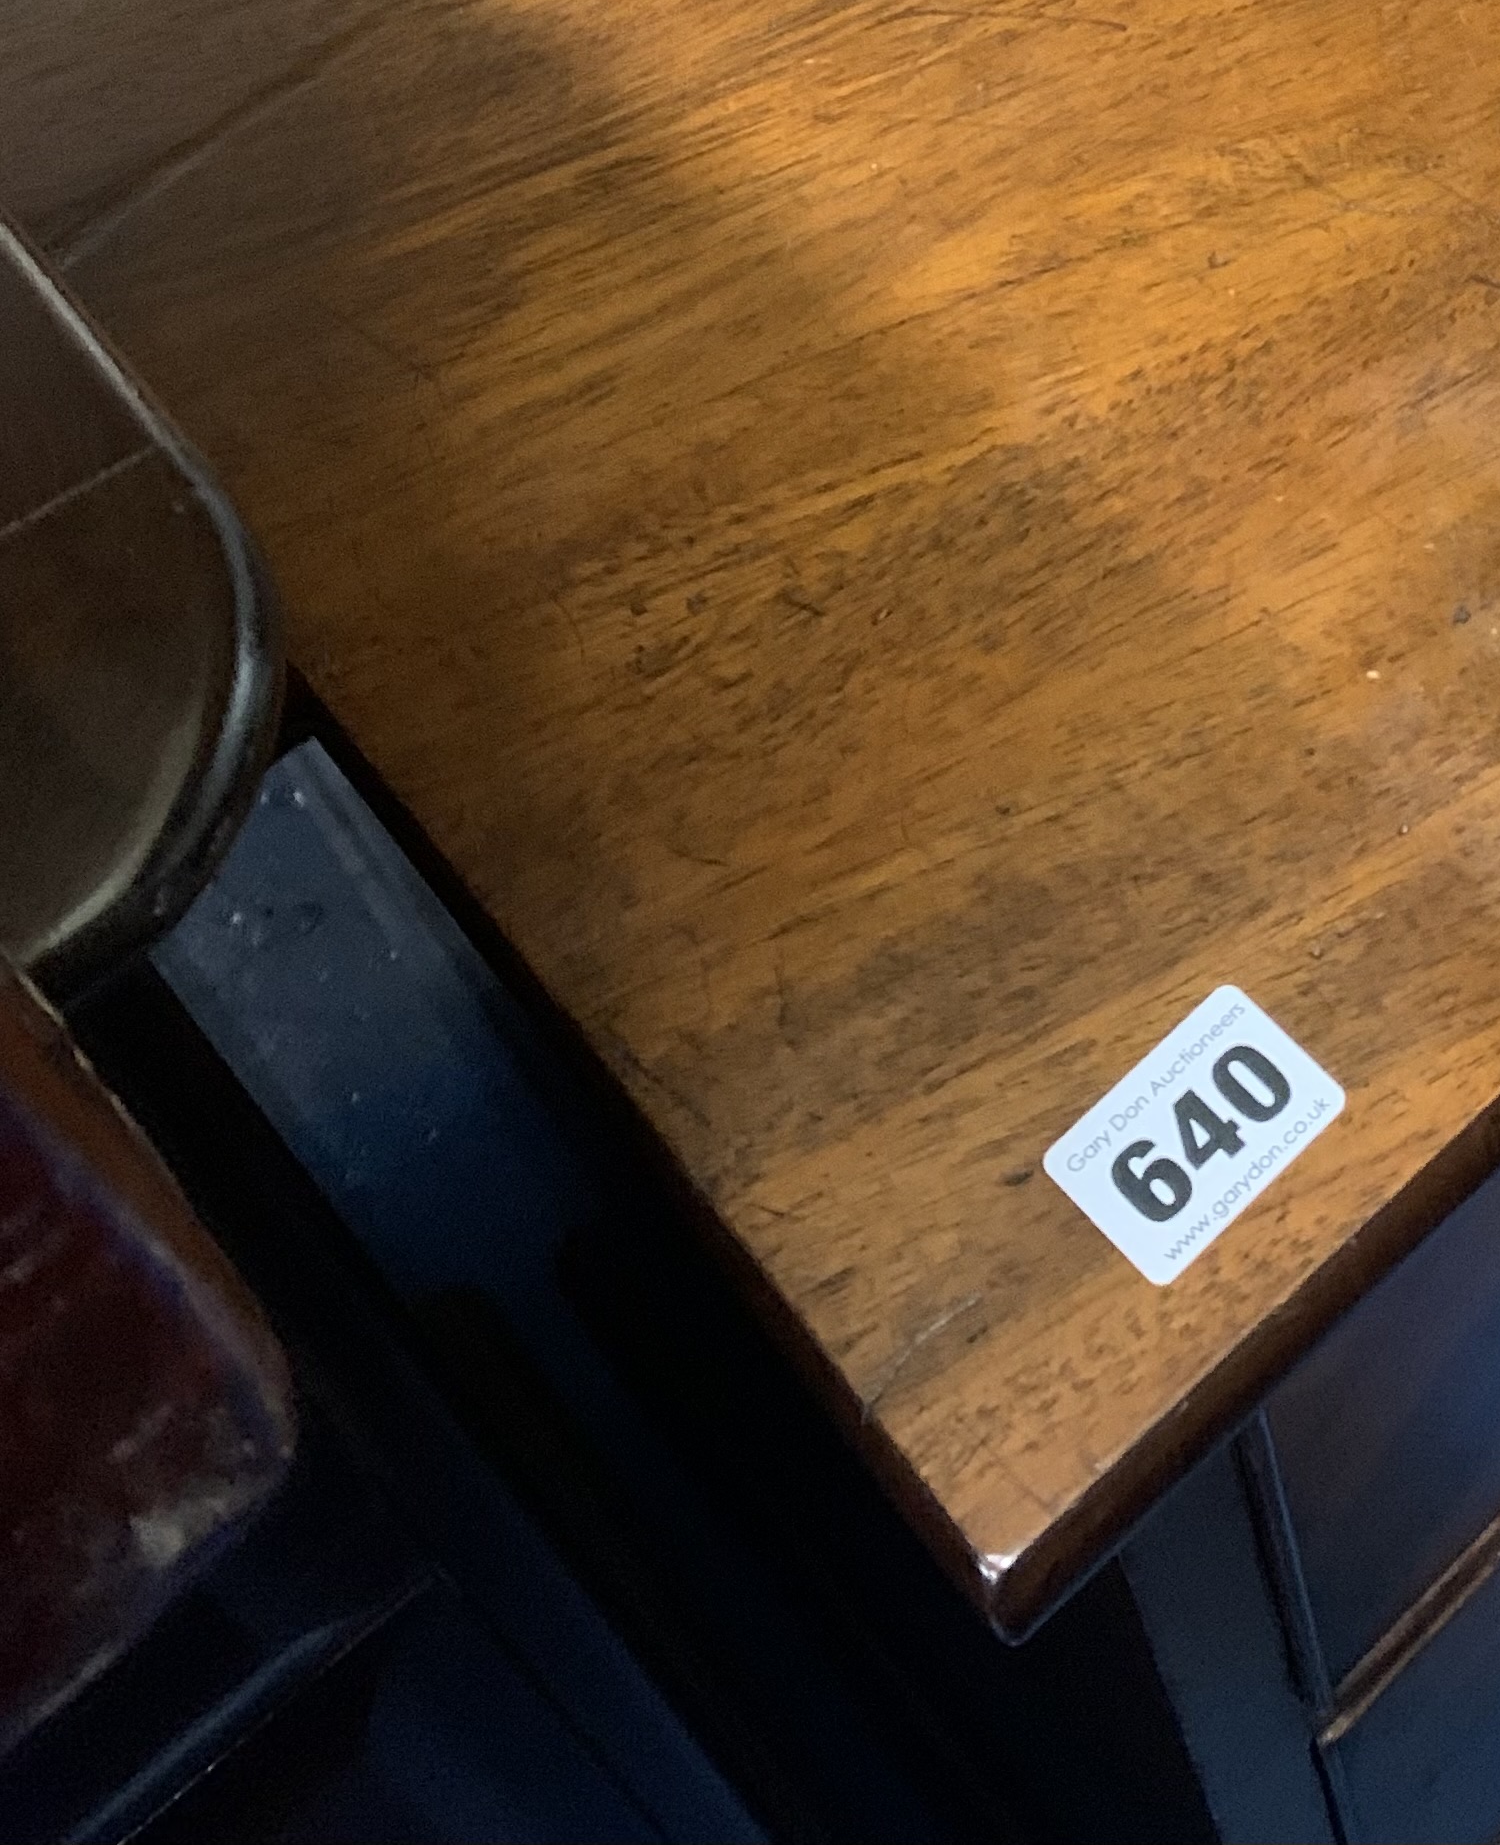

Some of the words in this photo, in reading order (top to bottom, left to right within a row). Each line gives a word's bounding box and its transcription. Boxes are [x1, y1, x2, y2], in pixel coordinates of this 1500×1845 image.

[1066, 1127, 1113, 1173] Gary
[1109, 1094, 1151, 1133] Don
[1149, 1002, 1246, 1097] Auctioneers
[1111, 1045, 1291, 1223] 640
[1164, 1097, 1331, 1260] www.garydon.co.uk
